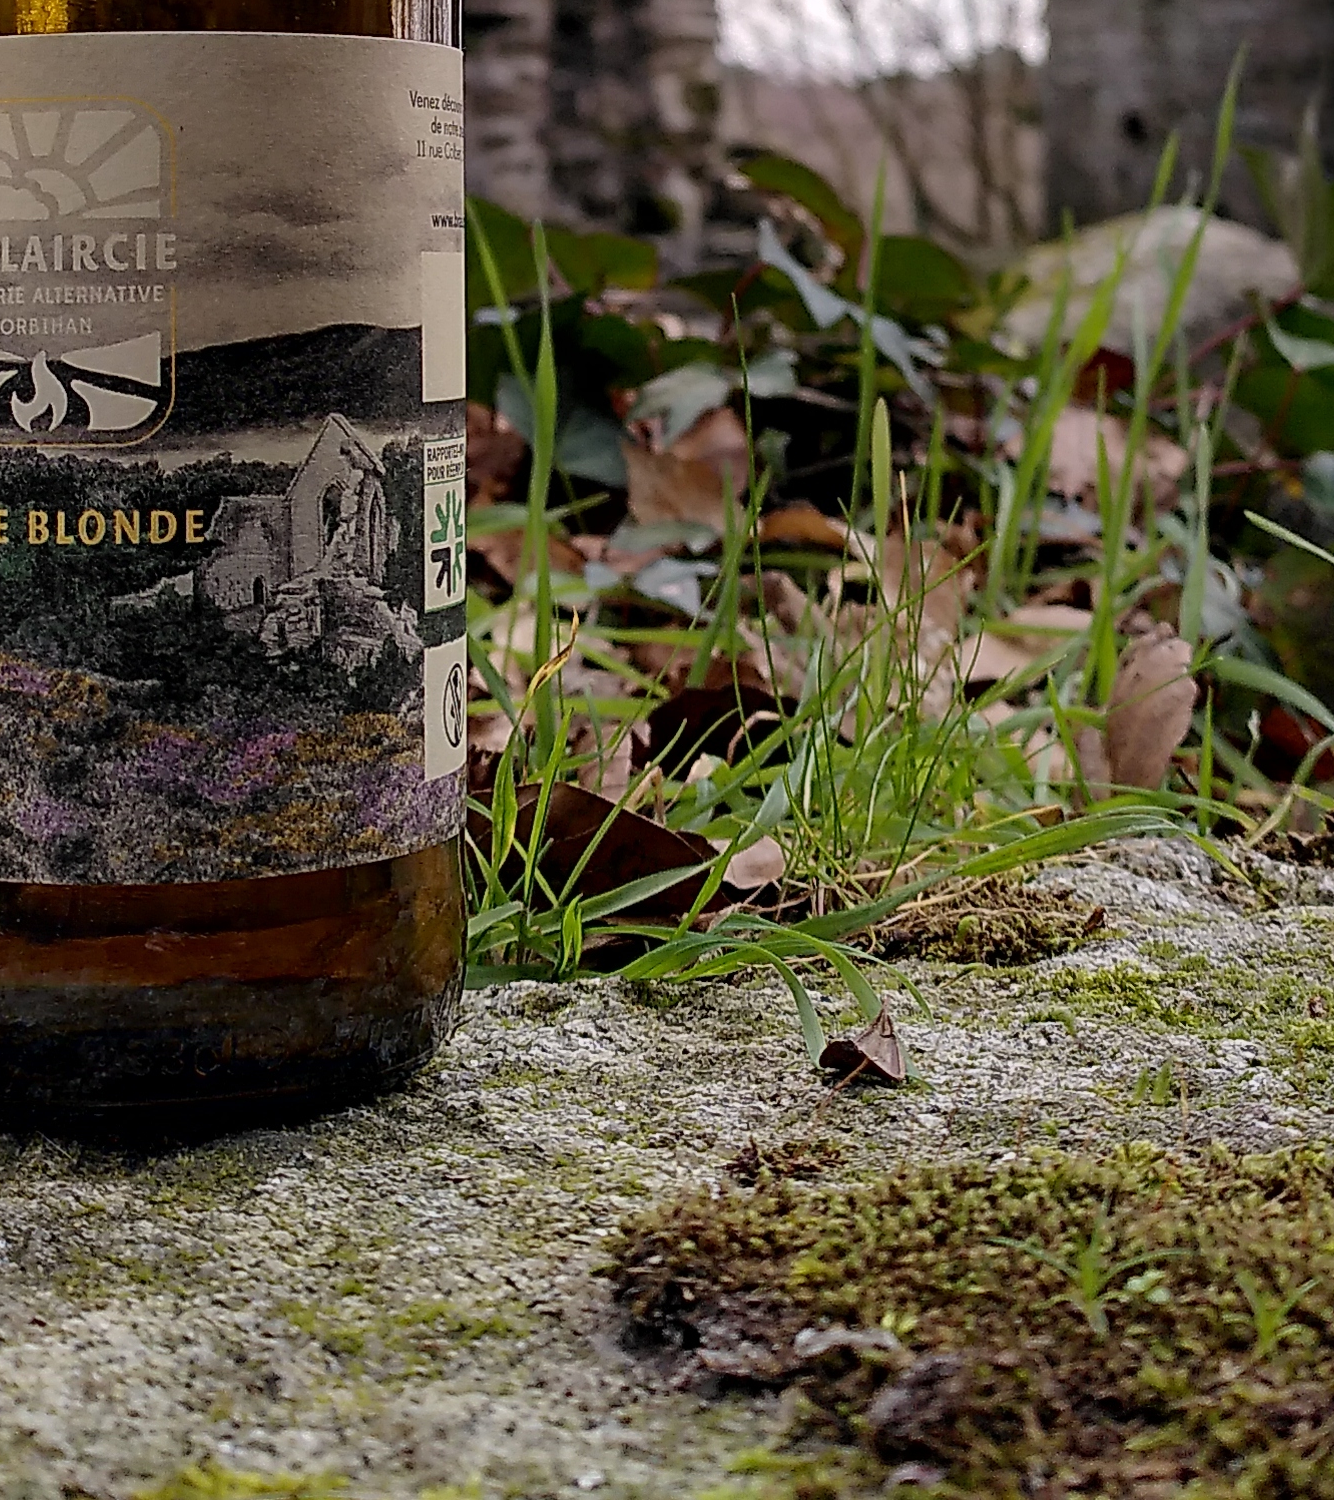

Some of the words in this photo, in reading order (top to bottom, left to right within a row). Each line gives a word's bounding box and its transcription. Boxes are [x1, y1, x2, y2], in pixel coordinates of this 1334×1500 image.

[409, 90, 440, 110] Venez
[430, 116, 442, 134] de
[416, 139, 426, 157] 11
[428, 145, 443, 159] rue
[31, 284, 165, 304] ALTERNATIVE
[427, 465, 445, 481] POUR
[27, 508, 205, 546] BLONDE
